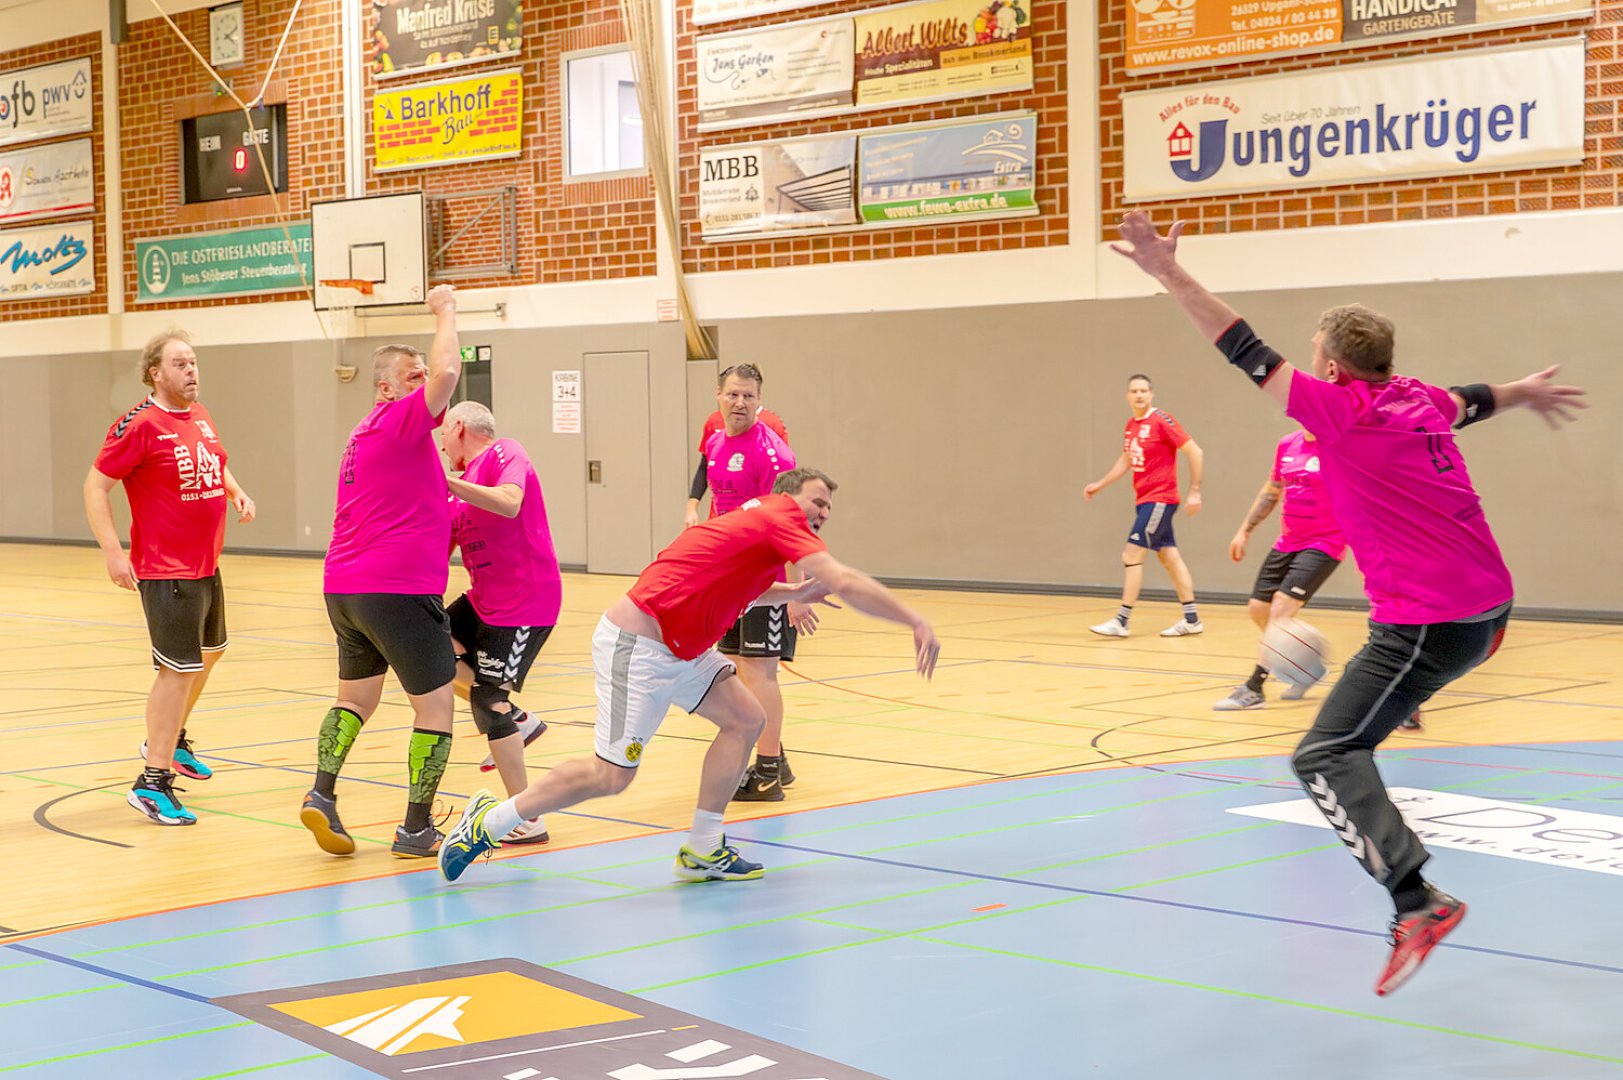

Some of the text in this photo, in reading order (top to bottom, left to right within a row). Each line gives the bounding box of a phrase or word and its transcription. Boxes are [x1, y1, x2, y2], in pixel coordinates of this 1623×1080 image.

[396, 2, 452, 34] Manfred
[455, 0, 495, 23] Kruse
[1231, 20, 1250, 31] Tel.
[1250, 15, 1282, 29] 04934
[1291, 11, 1306, 24] 80
[1307, 10, 1321, 21] 44
[1323, 7, 1338, 19] 39
[1362, 11, 1456, 36] GARTENGERÄTE
[861, 16, 968, 59] Albert Wilts
[1133, 24, 1335, 65] www.revox-online-shop.de
[712, 58, 735, 73] Jens
[738, 52, 775, 70] Gerken
[884, 58, 934, 74] Spezialitäten
[42, 84, 71, 119] pwv
[400, 83, 491, 120] Barkhoff
[1159, 93, 1241, 122] Alles für den Bau
[1261, 104, 1361, 124] Seit über 70 Jahren
[442, 114, 473, 145] Bau
[1170, 98, 1537, 182] Jungenkrüger
[236, 150, 246, 171] 0
[703, 155, 759, 182] MBB
[993, 160, 1022, 174] Extra
[884, 193, 1008, 218] www.fewo-extra.de
[172, 251, 189, 265] DIE
[174, 445, 202, 490] MBB
